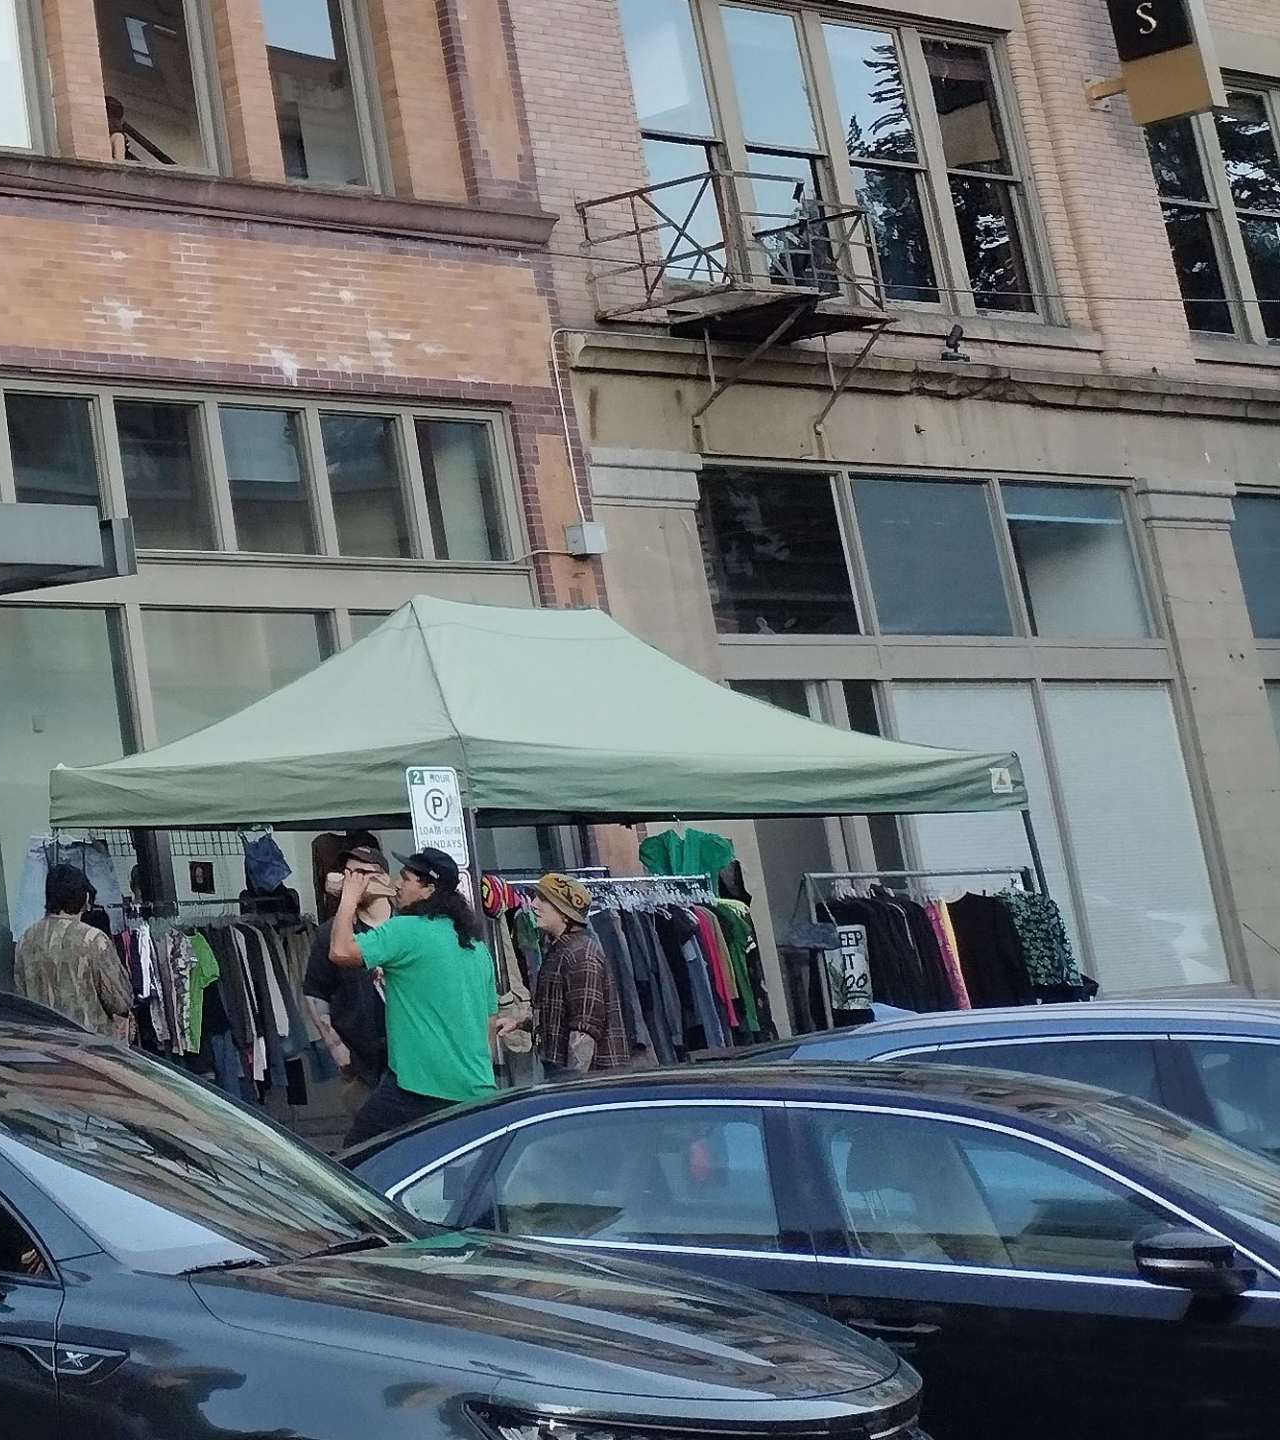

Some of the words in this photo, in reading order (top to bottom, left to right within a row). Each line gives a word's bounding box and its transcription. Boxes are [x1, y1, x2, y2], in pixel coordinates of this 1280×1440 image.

[413, 772, 421, 783] 2
[431, 796, 443, 815] P
[420, 839, 463, 848] SUNDAYS
